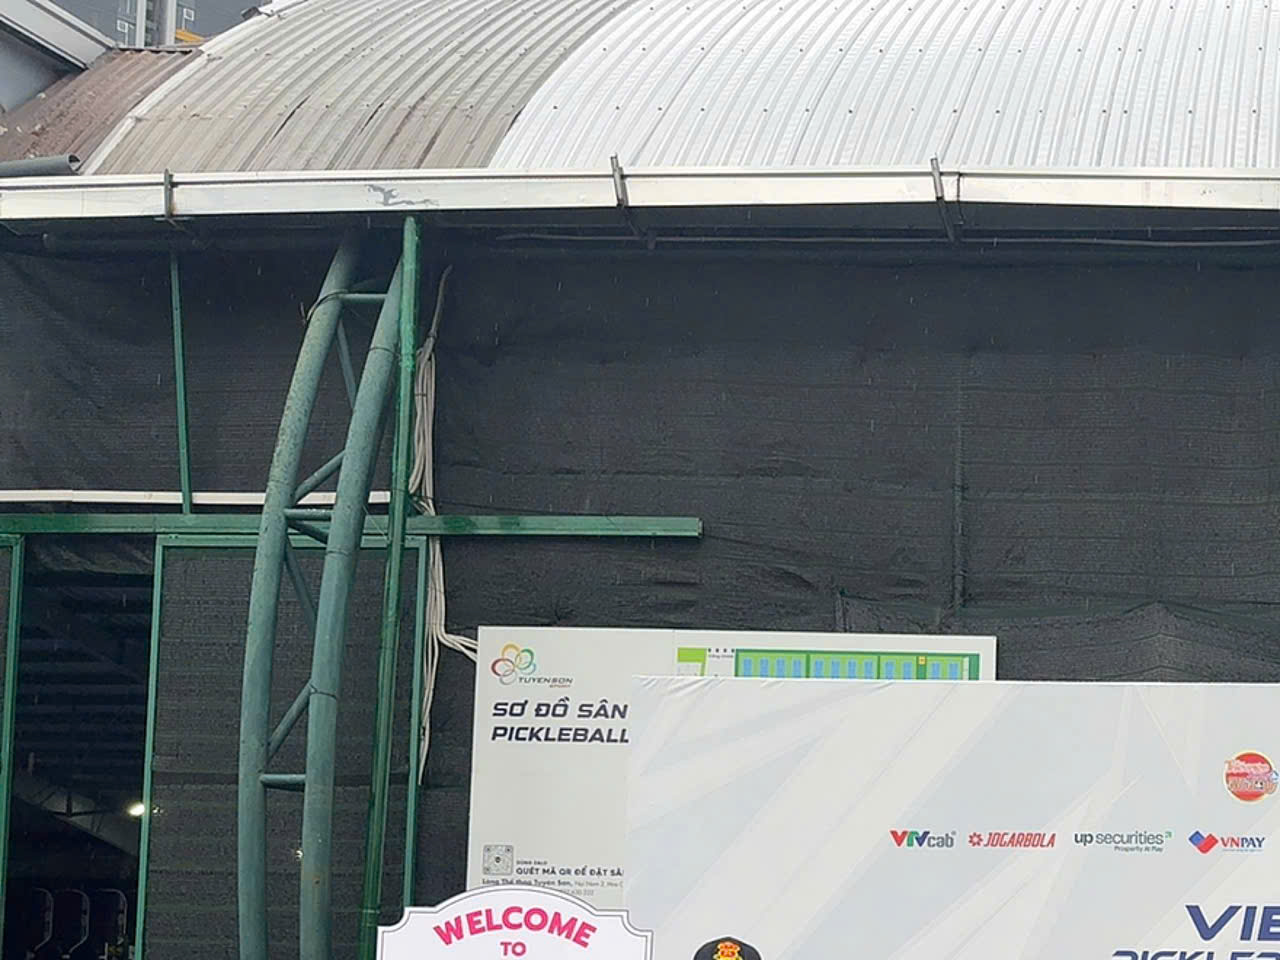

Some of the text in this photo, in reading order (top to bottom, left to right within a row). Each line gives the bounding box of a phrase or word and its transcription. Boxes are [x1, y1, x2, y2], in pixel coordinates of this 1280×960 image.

[492, 696, 629, 719] SƠ ĐỒ SÂN
[491, 727, 629, 744] PICKLEBALL
[1074, 830, 1164, 847] up securities
[1220, 837, 1266, 848] VNPAY
[432, 905, 597, 950] WELCOME
[500, 941, 527, 957] TO
